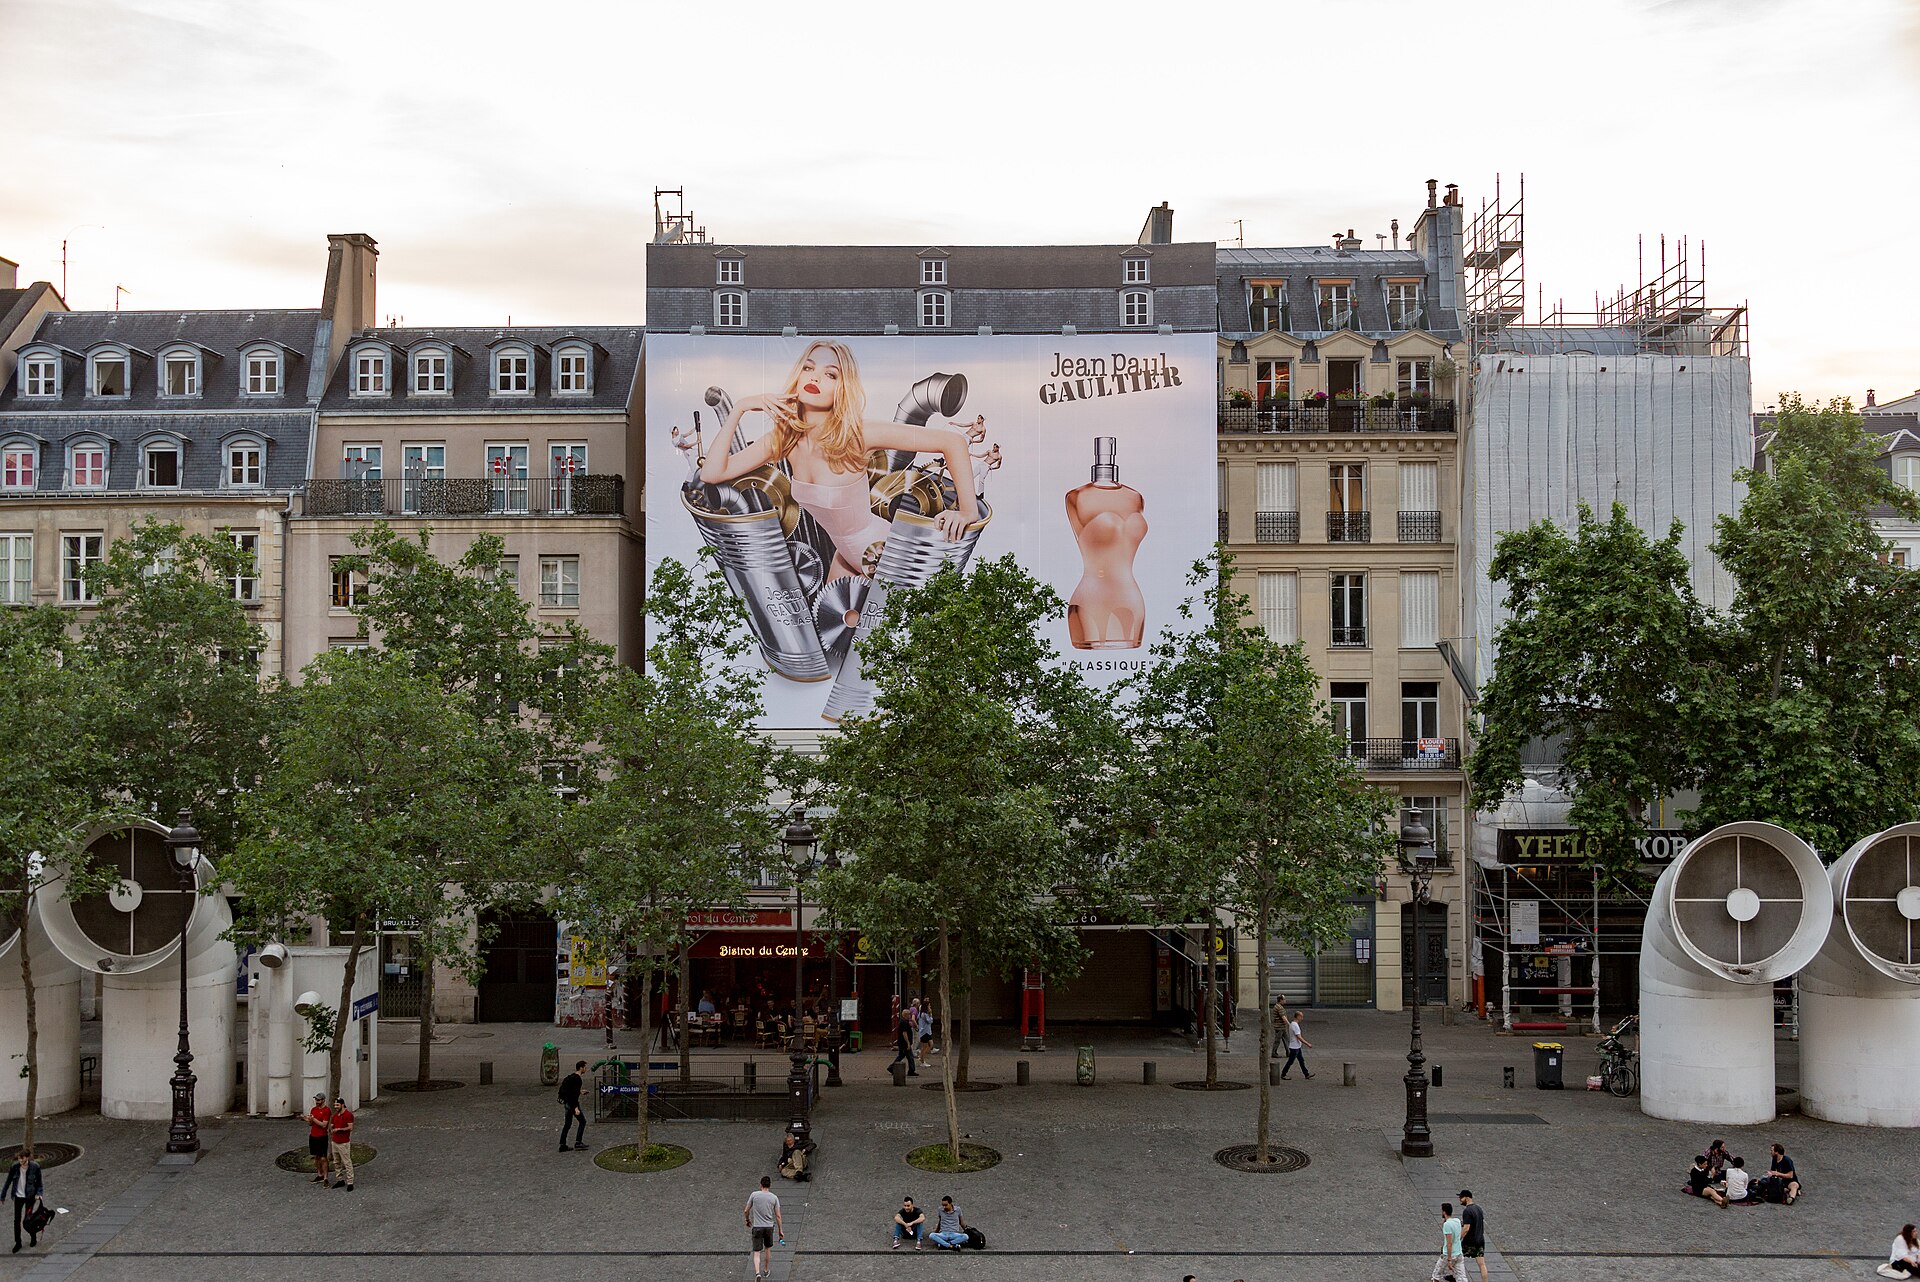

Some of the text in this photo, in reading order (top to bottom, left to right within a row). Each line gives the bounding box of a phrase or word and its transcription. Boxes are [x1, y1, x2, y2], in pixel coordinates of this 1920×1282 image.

[1050, 352, 1107, 378] Jean
[1038, 365, 1183, 405] GAULTIER
[1514, 836, 1602, 859] YELLO
[719, 945, 755, 957] Bistrot
[759, 945, 773, 957] du
